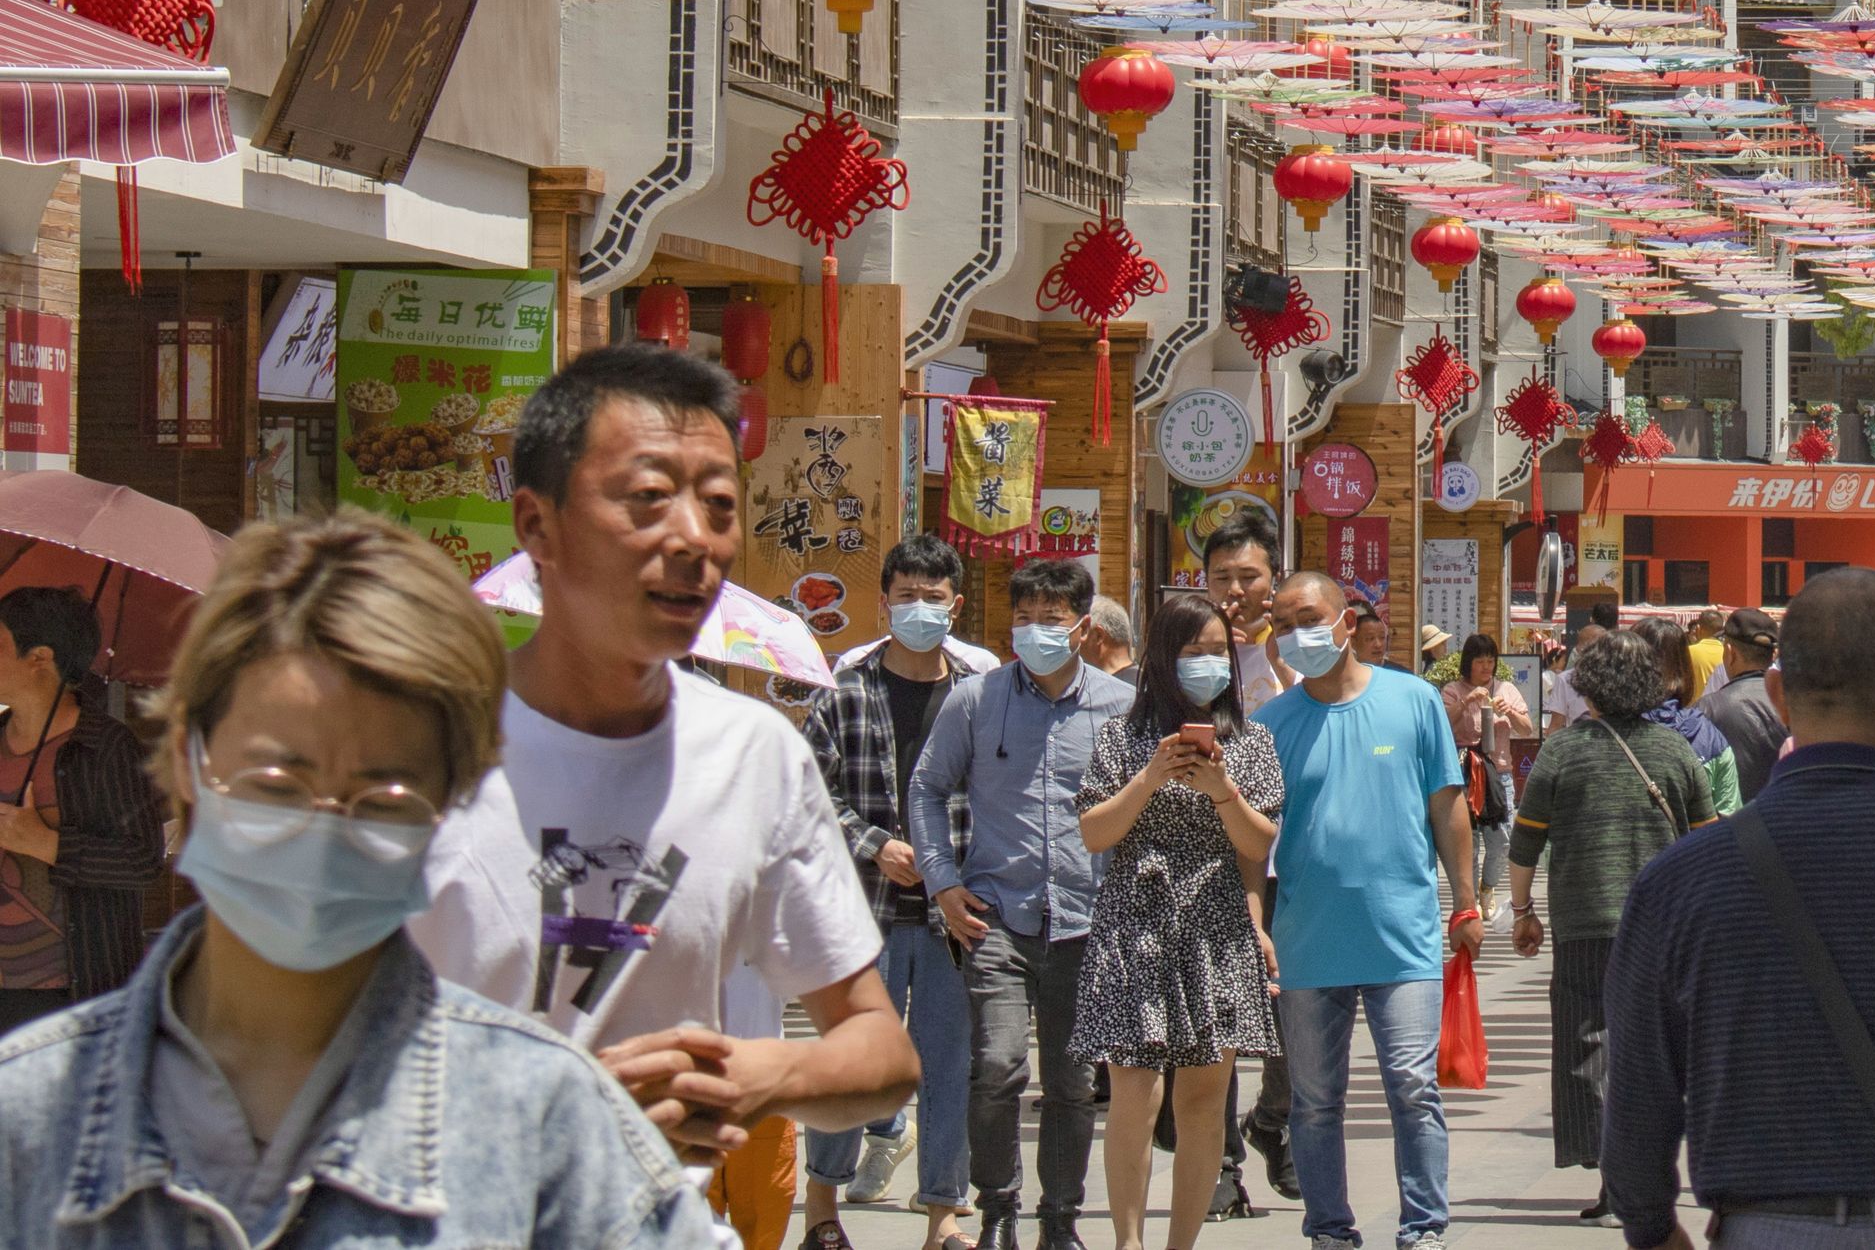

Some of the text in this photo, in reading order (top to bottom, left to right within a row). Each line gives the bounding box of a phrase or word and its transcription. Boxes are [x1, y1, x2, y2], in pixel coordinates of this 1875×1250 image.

[390, 293, 548, 334] 每日优鲜
[407, 328, 444, 345] daily
[446, 331, 504, 347] optimal
[10, 341, 67, 373] WELCOME TO
[391, 354, 493, 395] 爆米花
[9, 379, 44, 407] SUNTEA
[1189, 452, 1216, 463] 奶茶
[1728, 477, 1824, 509] 来伊份
[1584, 548, 1619, 561] 芒太后
